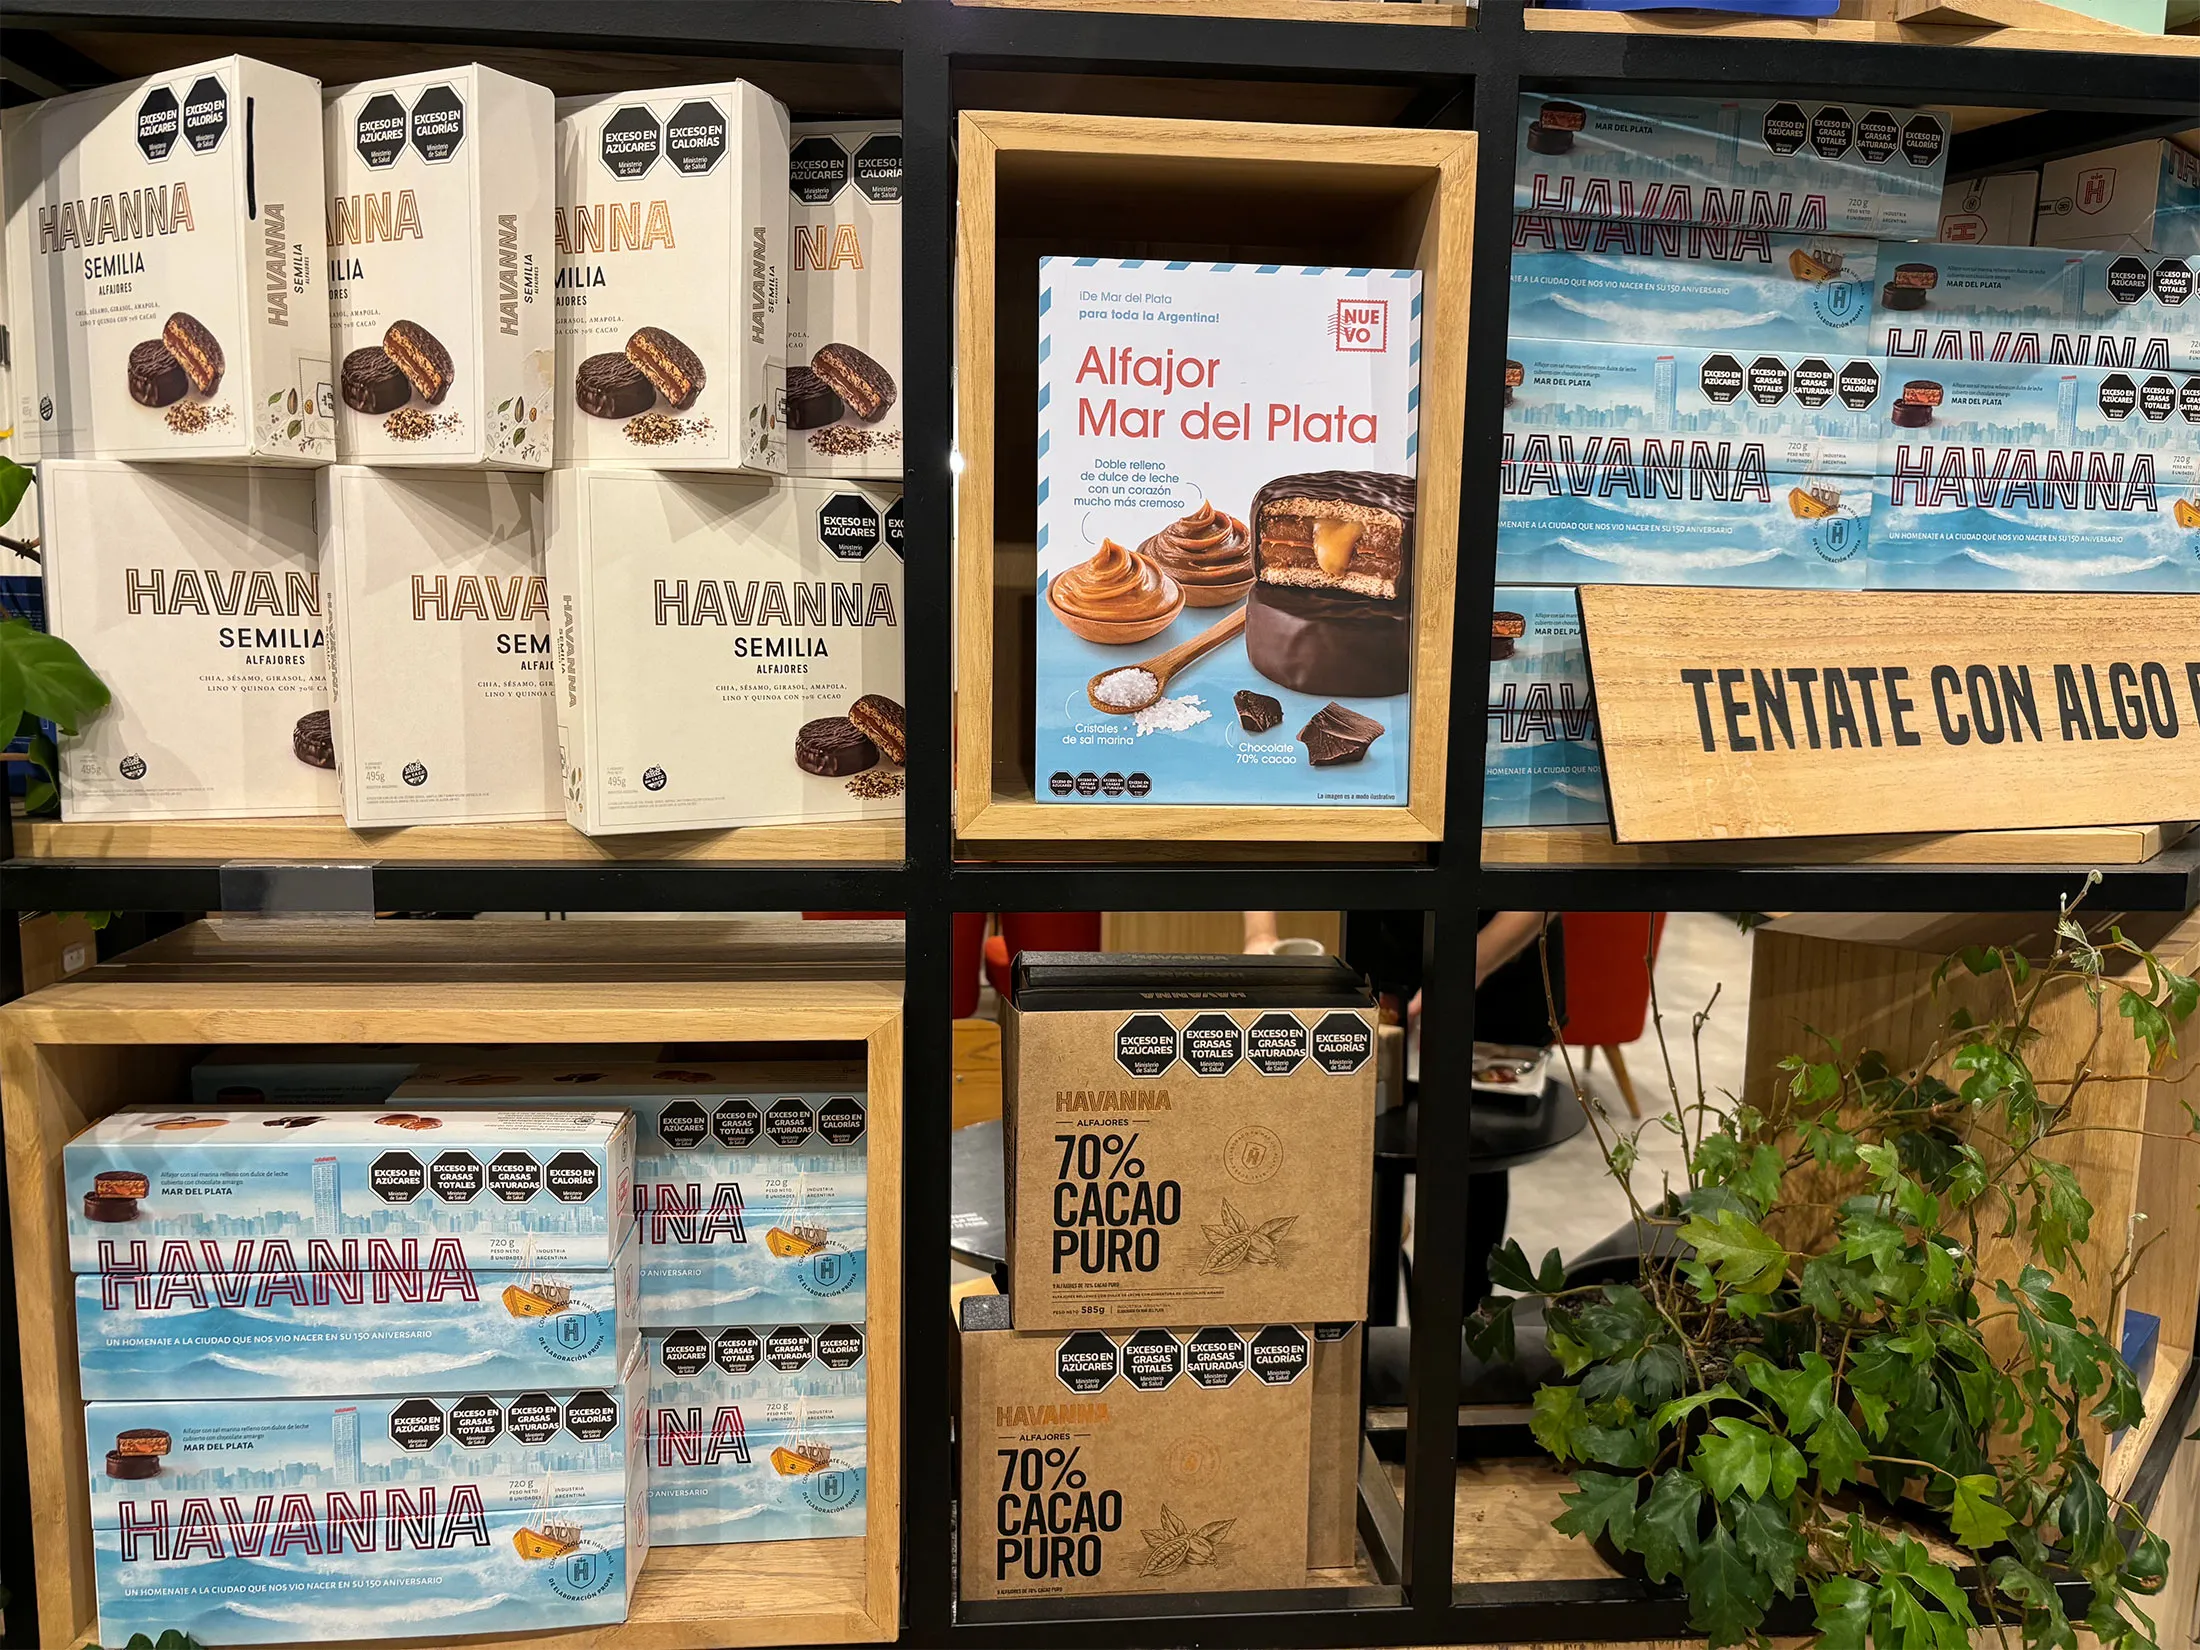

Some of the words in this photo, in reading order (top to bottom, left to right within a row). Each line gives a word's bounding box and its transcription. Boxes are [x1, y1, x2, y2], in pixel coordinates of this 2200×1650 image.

[606, 132, 642, 142] EXCESO
[644, 130, 657, 140] EN
[670, 126, 706, 138] EXCESO
[708, 125, 722, 134] EN
[606, 140, 656, 154] AZÚCARES
[672, 136, 720, 149] CALORÍAS
[39, 181, 195, 255] HAVANNA
[84, 252, 145, 280] SEMILIA
[264, 203, 289, 327] HAVANNA
[293, 244, 304, 294] SEMILIA
[498, 214, 519, 337] HAVANNA
[99, 282, 132, 296] ALFAJORES
[751, 226, 767, 345] HAVANNA
[1101, 292, 1122, 302] Mar
[1124, 293, 1142, 302] del
[1146, 294, 1172, 304] Plata
[1079, 310, 1107, 320] para
[1112, 310, 1138, 320] toda
[1143, 311, 1154, 320] la
[1157, 312, 1220, 324] Argentina!
[1344, 309, 1380, 325] NUE
[1344, 328, 1371, 343] VO
[1076, 346, 1220, 395] Alfajor
[1553, 378, 1567, 386] DEL
[1982, 398, 2002, 406] PLATA
[1078, 398, 1165, 438] Mar
[1180, 402, 1250, 440] del
[1268, 404, 1378, 444] Plata
[1095, 459, 1126, 470] Doble
[1130, 460, 1166, 470] relleno
[1080, 472, 1095, 481] de
[1098, 472, 1128, 482] dulce
[1132, 473, 1146, 482] de
[1150, 474, 1180, 483] leche
[1890, 445, 2158, 512] HAVANNA
[1088, 486, 1108, 494] con
[1112, 486, 1125, 494] un
[1128, 486, 1171, 495] corazón
[1074, 497, 1111, 506] mucho
[1114, 497, 1136, 507] más
[1139, 499, 1184, 508] cremoso
[823, 517, 860, 529] EXCESO
[862, 517, 876, 527] EN
[824, 524, 876, 538] AZÚCARES
[126, 568, 322, 616] HAVAN
[653, 579, 898, 627] HAVANNA
[734, 637, 828, 657] SEMILIA
[246, 655, 306, 664] ALFAJORES
[756, 664, 808, 674] ALFAJORES
[1681, 666, 1922, 753] TENTATE
[1929, 664, 2042, 746] CON
[2053, 662, 2179, 740] ALGO
[1075, 724, 1118, 733] Cristales
[1062, 735, 1076, 744] de
[1080, 735, 1094, 745] sal
[1097, 736, 1134, 745] marina
[1239, 742, 1294, 752] Chocolate
[1236, 754, 1258, 764] 70%
[1262, 756, 1296, 764] cacao
[608, 776, 626, 788] 495g
[1121, 1036, 1158, 1046] EXCESO
[1160, 1036, 1174, 1044] EN
[1186, 1030, 1223, 1040] EXCESO
[1225, 1030, 1238, 1038] EN
[1316, 1034, 1352, 1043] EXCESO
[1354, 1034, 1368, 1042] EN
[1121, 1044, 1173, 1055] AZÚCARES
[1193, 1040, 1232, 1048] GRASAS
[1318, 1041, 1365, 1052] CALORÍAS
[1191, 1049, 1234, 1058] TOTALES
[1056, 1090, 1172, 1112] HAVANNA
[1076, 1118, 1129, 1126] ALFAJORES
[1054, 1133, 1145, 1180] 70%
[204, 1187, 232, 1195] PLATA
[1053, 1180, 1181, 1227] CACAO
[490, 1239, 506, 1248] 720
[508, 1240, 515, 1248] g
[1052, 1228, 1160, 1274] PURO
[98, 1238, 480, 1310] HAVANNA
[1081, 1306, 1105, 1315] 585g
[122, 1338, 172, 1346] HOMENAJE
[232, 1336, 251, 1344] QUE
[294, 1334, 323, 1342] NACER
[354, 1332, 369, 1342] 150
[371, 1331, 432, 1340] ANIVERSARIO
[996, 1402, 1110, 1427] HAVANNA
[1019, 1432, 1071, 1442] ALFAJORES
[997, 1446, 1086, 1492] 70%
[997, 1490, 1122, 1536] CACAO
[118, 1484, 490, 1562] HAVANNA
[996, 1534, 1101, 1581] PURO
